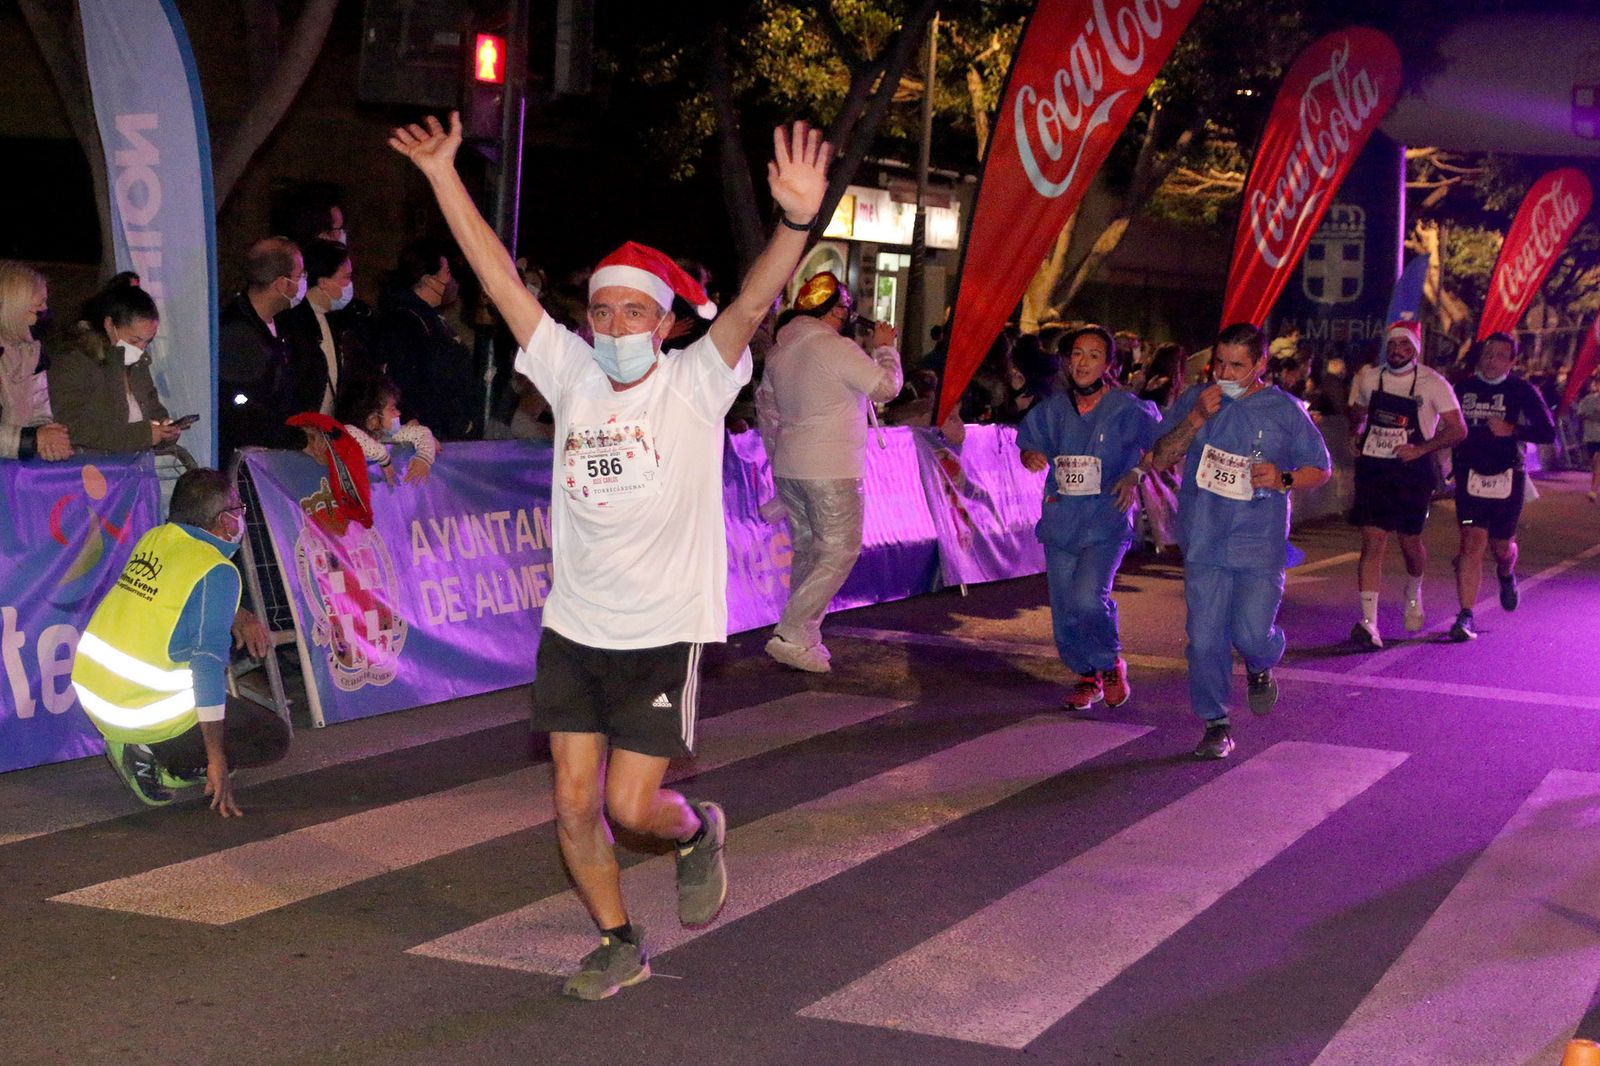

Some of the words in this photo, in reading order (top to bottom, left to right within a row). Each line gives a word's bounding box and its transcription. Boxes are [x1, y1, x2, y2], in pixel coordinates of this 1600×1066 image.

[1014, 0, 1181, 198] Coca-Co
[587, 457, 623, 478] 586
[1214, 469, 1236, 485] 253
[1065, 473, 1084, 484] 220
[133, 578, 158, 595] Event
[420, 576, 468, 626] DE
